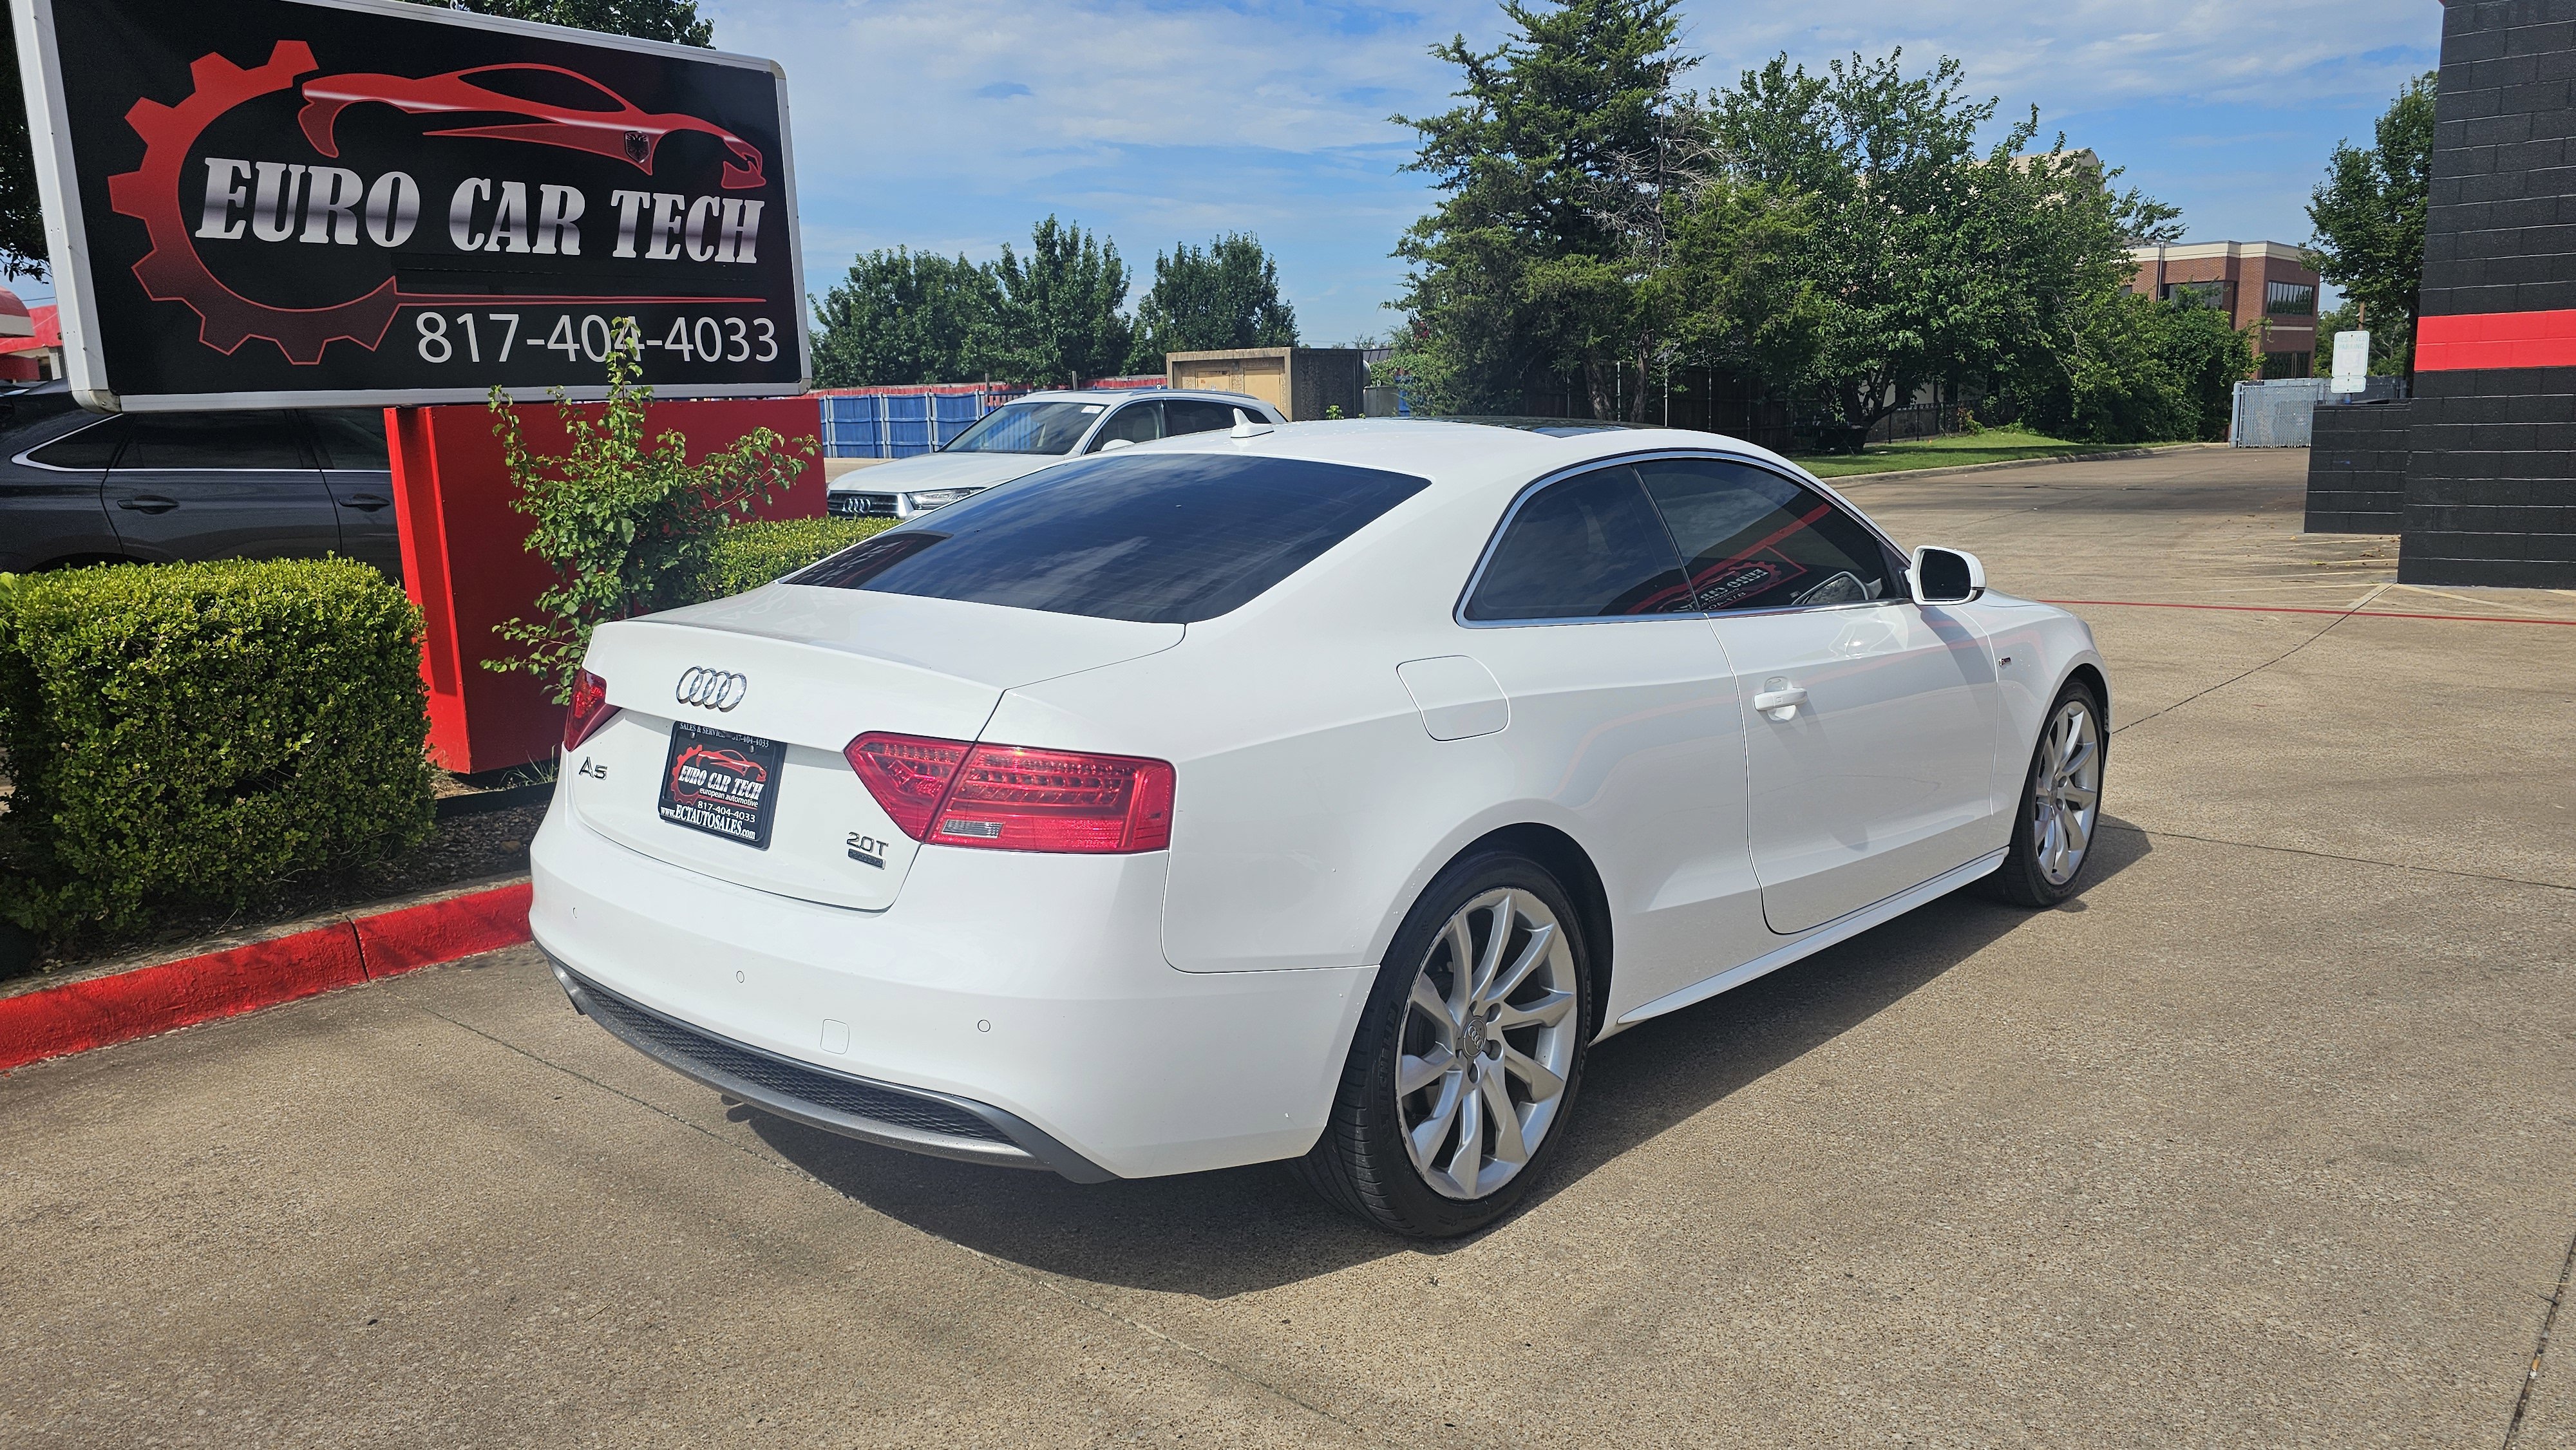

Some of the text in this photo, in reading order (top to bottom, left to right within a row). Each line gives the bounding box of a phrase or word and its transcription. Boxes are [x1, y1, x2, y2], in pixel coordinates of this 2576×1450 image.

[196, 156, 766, 265] EURO CAR TECH
[415, 312, 779, 363] 817-404-4033
[679, 722, 696, 732] SALES
[579, 756, 608, 780] A5
[678, 765, 765, 800] EURO CAR TECH
[697, 800, 756, 823] 817-404-4033
[699, 787, 759, 808] european automotive
[660, 804, 756, 840] www.ECTAUTOSALES.com
